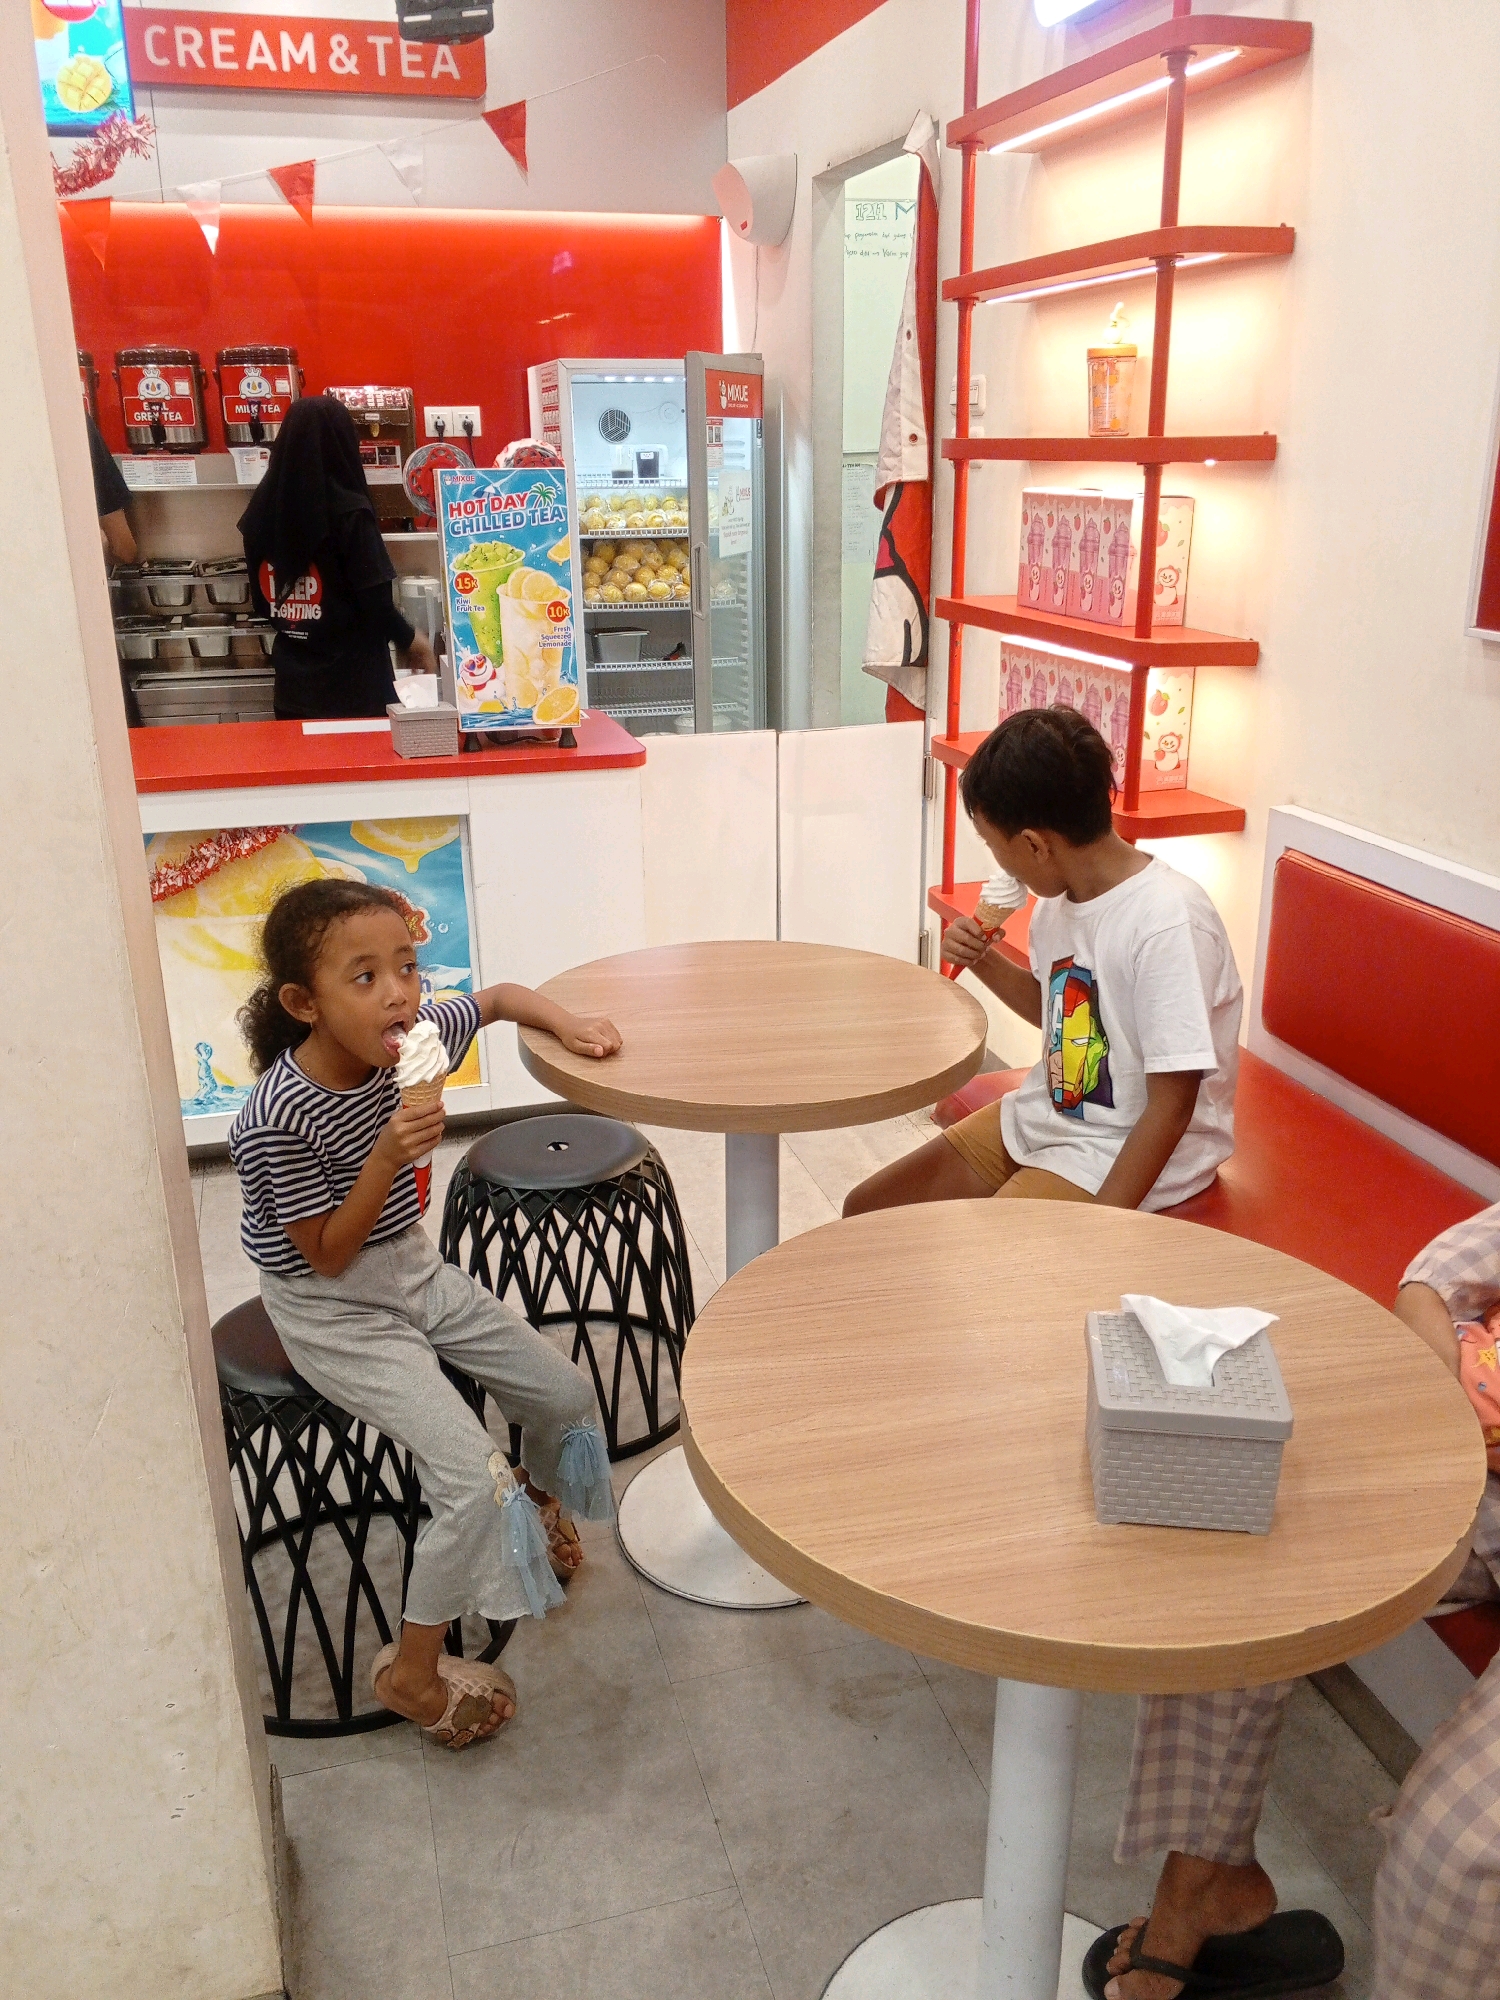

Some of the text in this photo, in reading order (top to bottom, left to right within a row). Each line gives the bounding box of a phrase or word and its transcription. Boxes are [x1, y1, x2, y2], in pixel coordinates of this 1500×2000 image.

[143, 25, 461, 79] CREAM & TEA
[727, 383, 749, 402] MIXUE
[143, 402, 169, 411] EL
[235, 404, 281, 414] MILK TEA
[162, 412, 182, 421] TEA
[449, 492, 528, 518] HOT DAY
[450, 505, 564, 536] CHILLED TEA
[269, 574, 318, 601] EP
[456, 577, 478, 590] 15K
[549, 606, 570, 618] 10K
[541, 633, 572, 641] Squeezed
